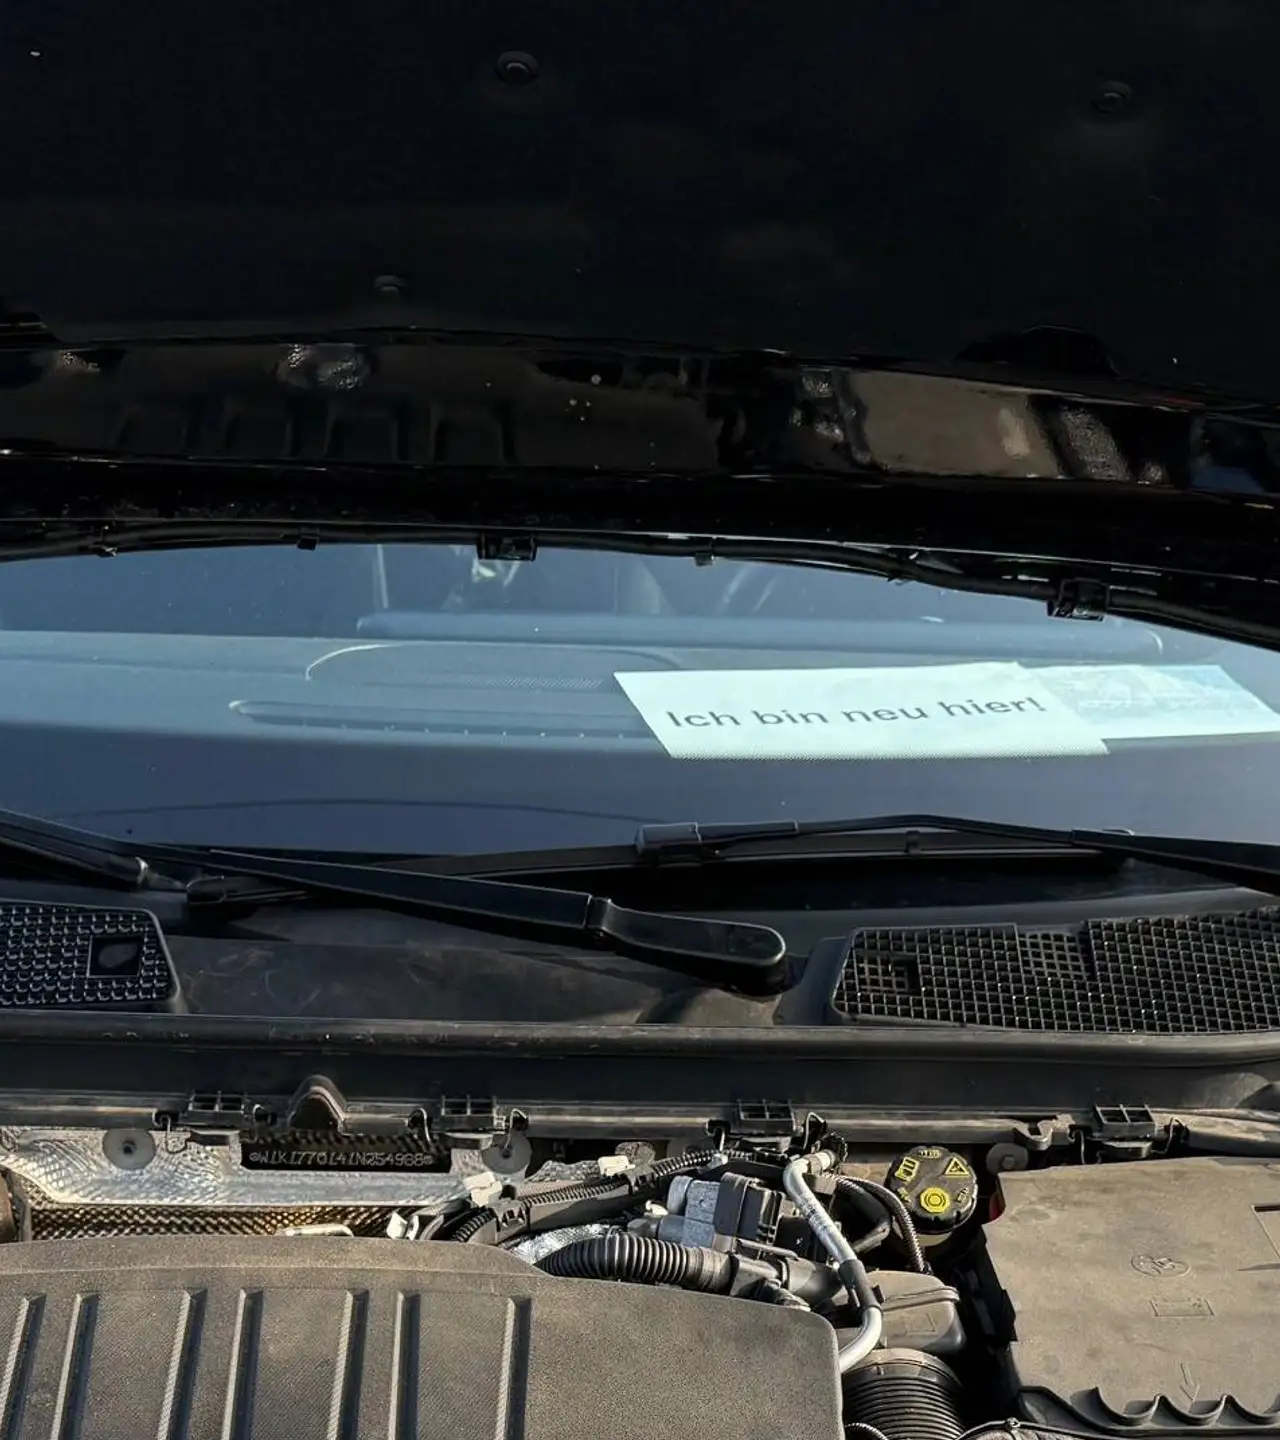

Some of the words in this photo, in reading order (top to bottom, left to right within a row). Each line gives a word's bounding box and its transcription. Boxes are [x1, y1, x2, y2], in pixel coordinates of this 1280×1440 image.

[666, 709, 740, 728] Ich
[752, 709, 829, 726] bin
[841, 704, 928, 724] neu
[937, 696, 1048, 718] hier!
